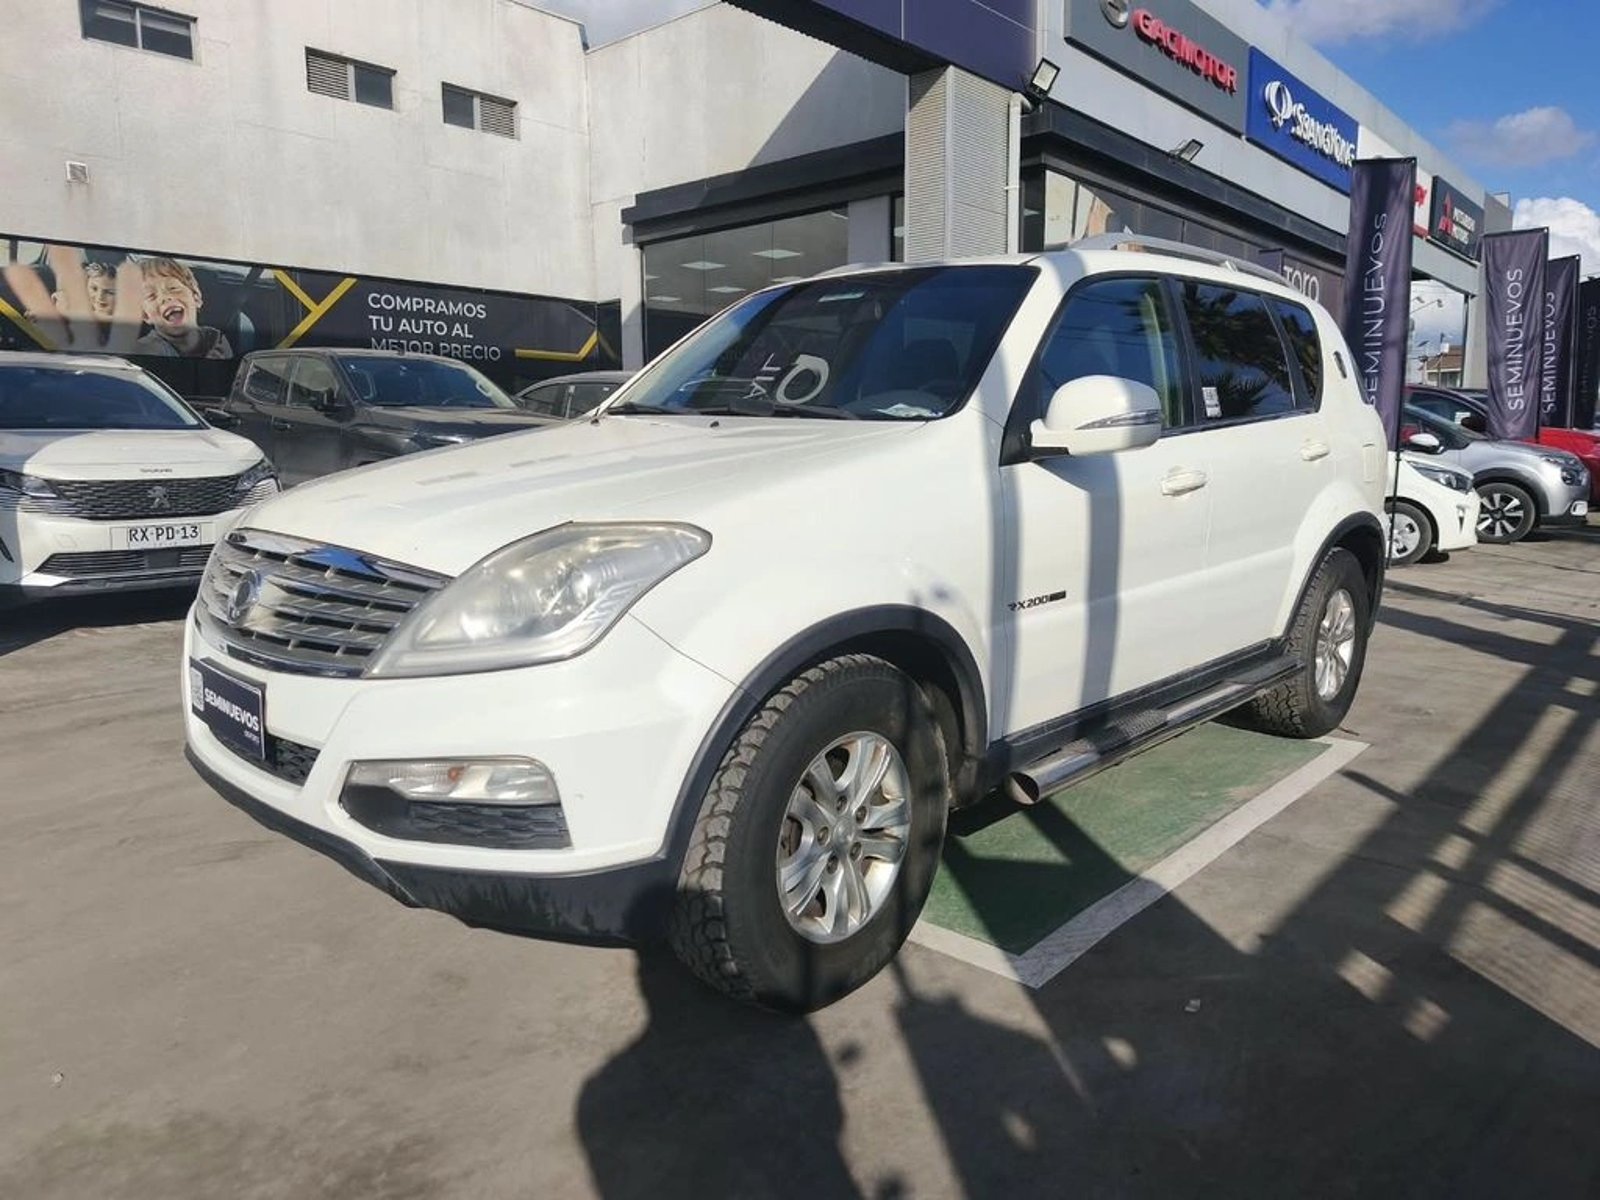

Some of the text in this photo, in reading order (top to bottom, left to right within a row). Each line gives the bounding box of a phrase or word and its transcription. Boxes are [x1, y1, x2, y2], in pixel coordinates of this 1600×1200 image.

[368, 293, 487, 318] COMPRAMOS
[368, 315, 474, 338] TU AUTO AL
[1505, 267, 1525, 411] SEMINUEVOS
[371, 337, 501, 361] MEJOR PRECIO
[203, 687, 260, 732] SEMINUEVOS
